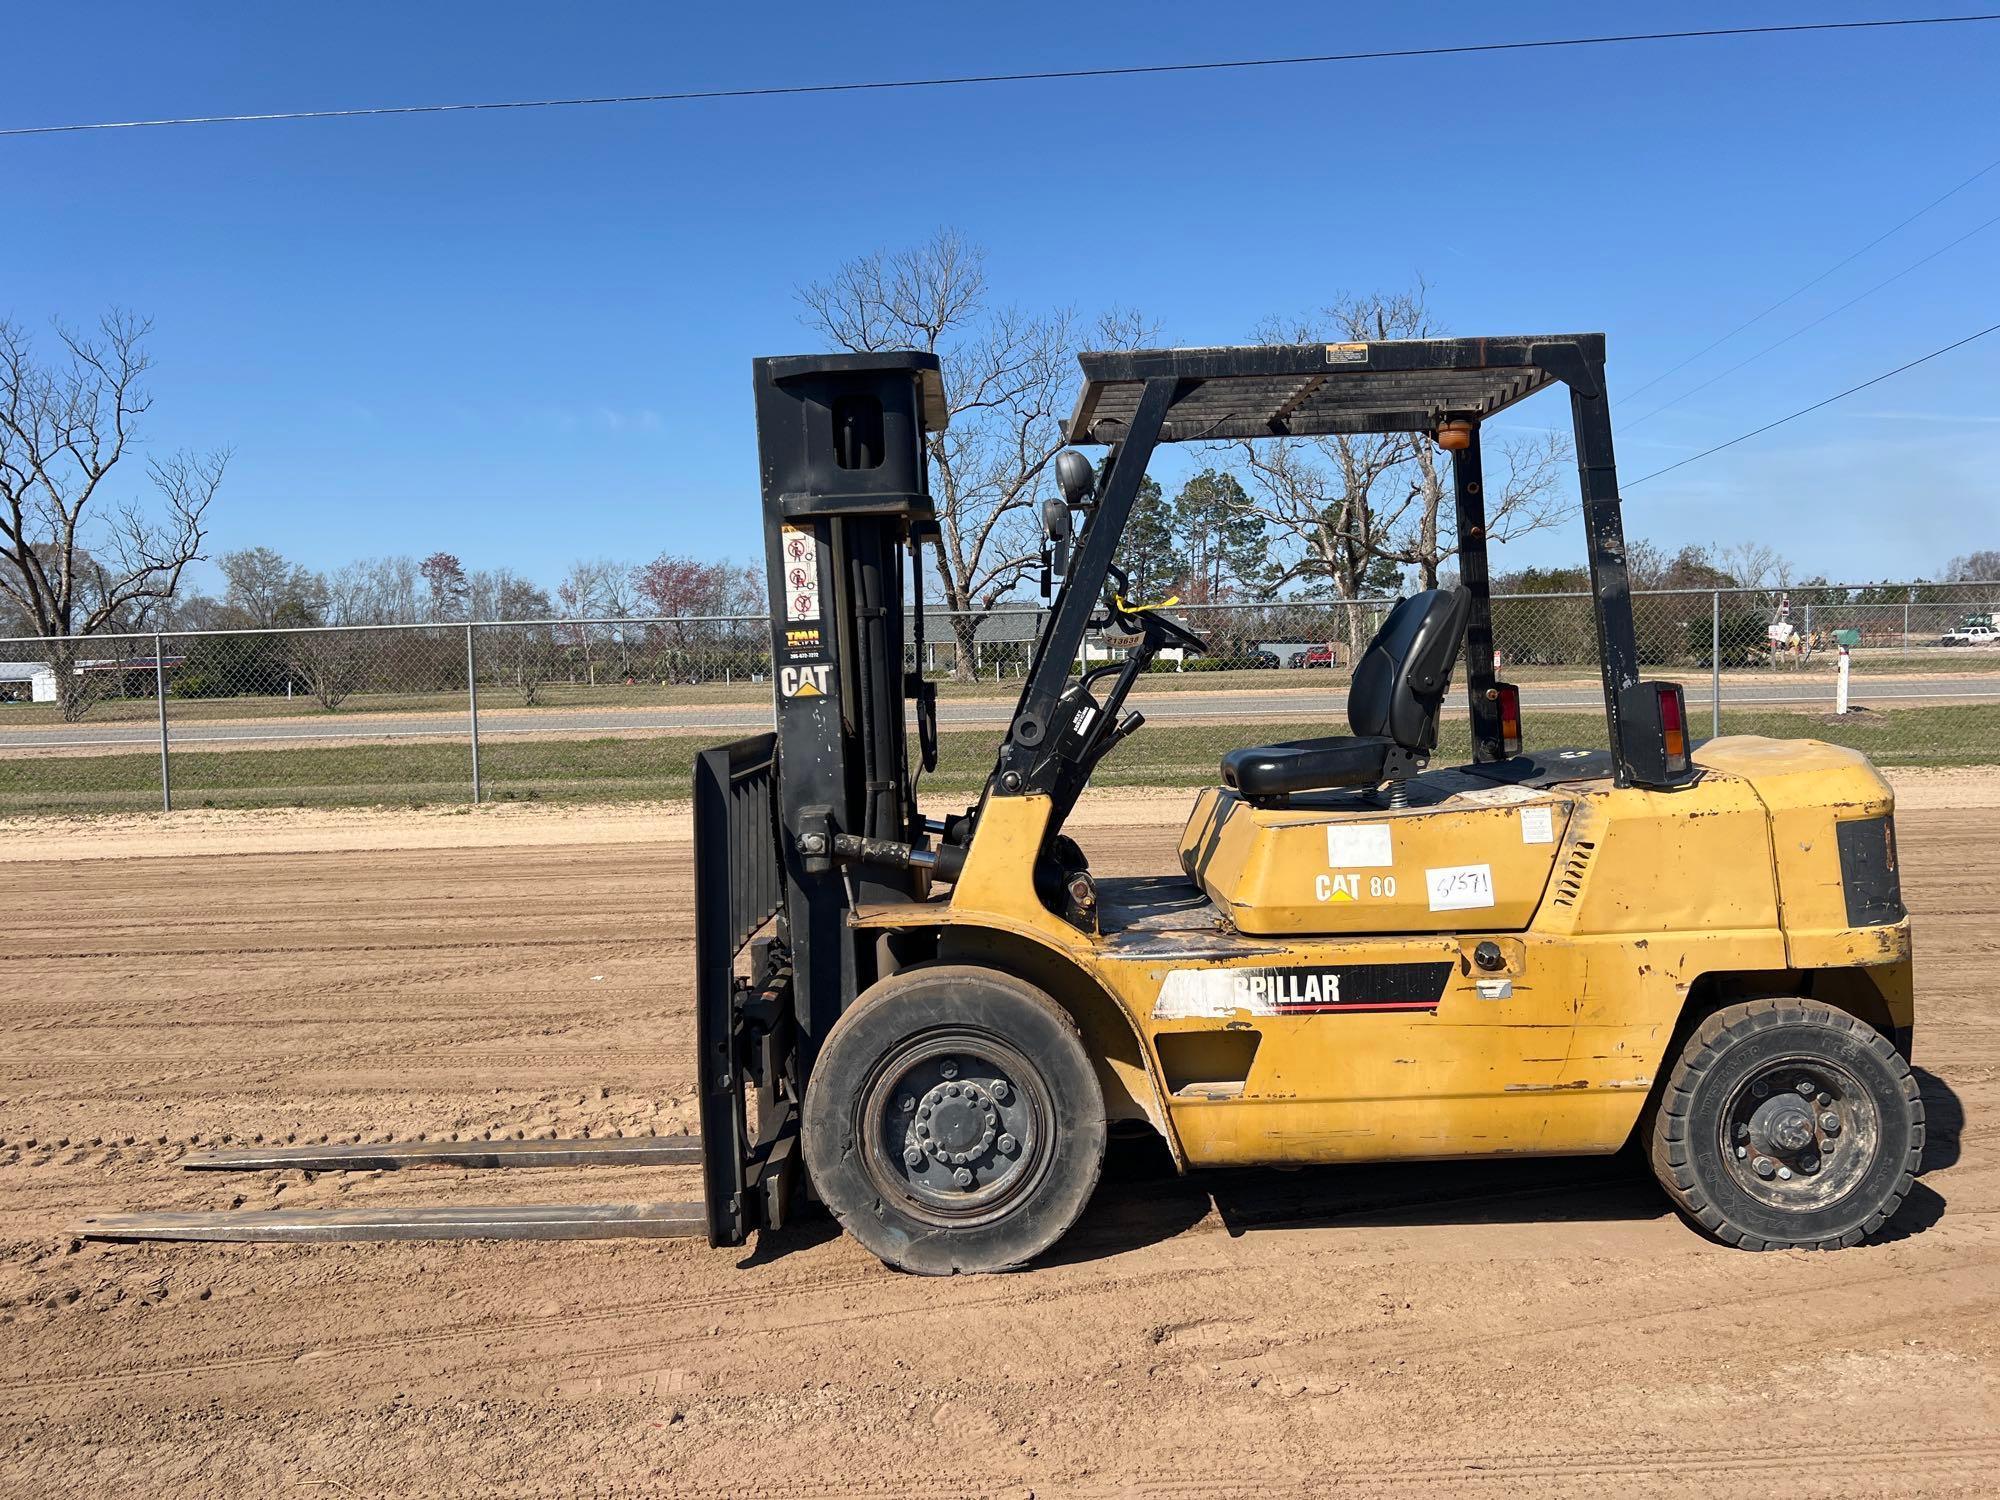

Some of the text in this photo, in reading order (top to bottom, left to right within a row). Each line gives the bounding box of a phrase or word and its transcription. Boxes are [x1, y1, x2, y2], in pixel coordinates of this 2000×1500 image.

[781, 665, 830, 697] CAT
[1315, 874, 1396, 902] CAT 80
[1233, 974, 1341, 1003] RPILLAR
